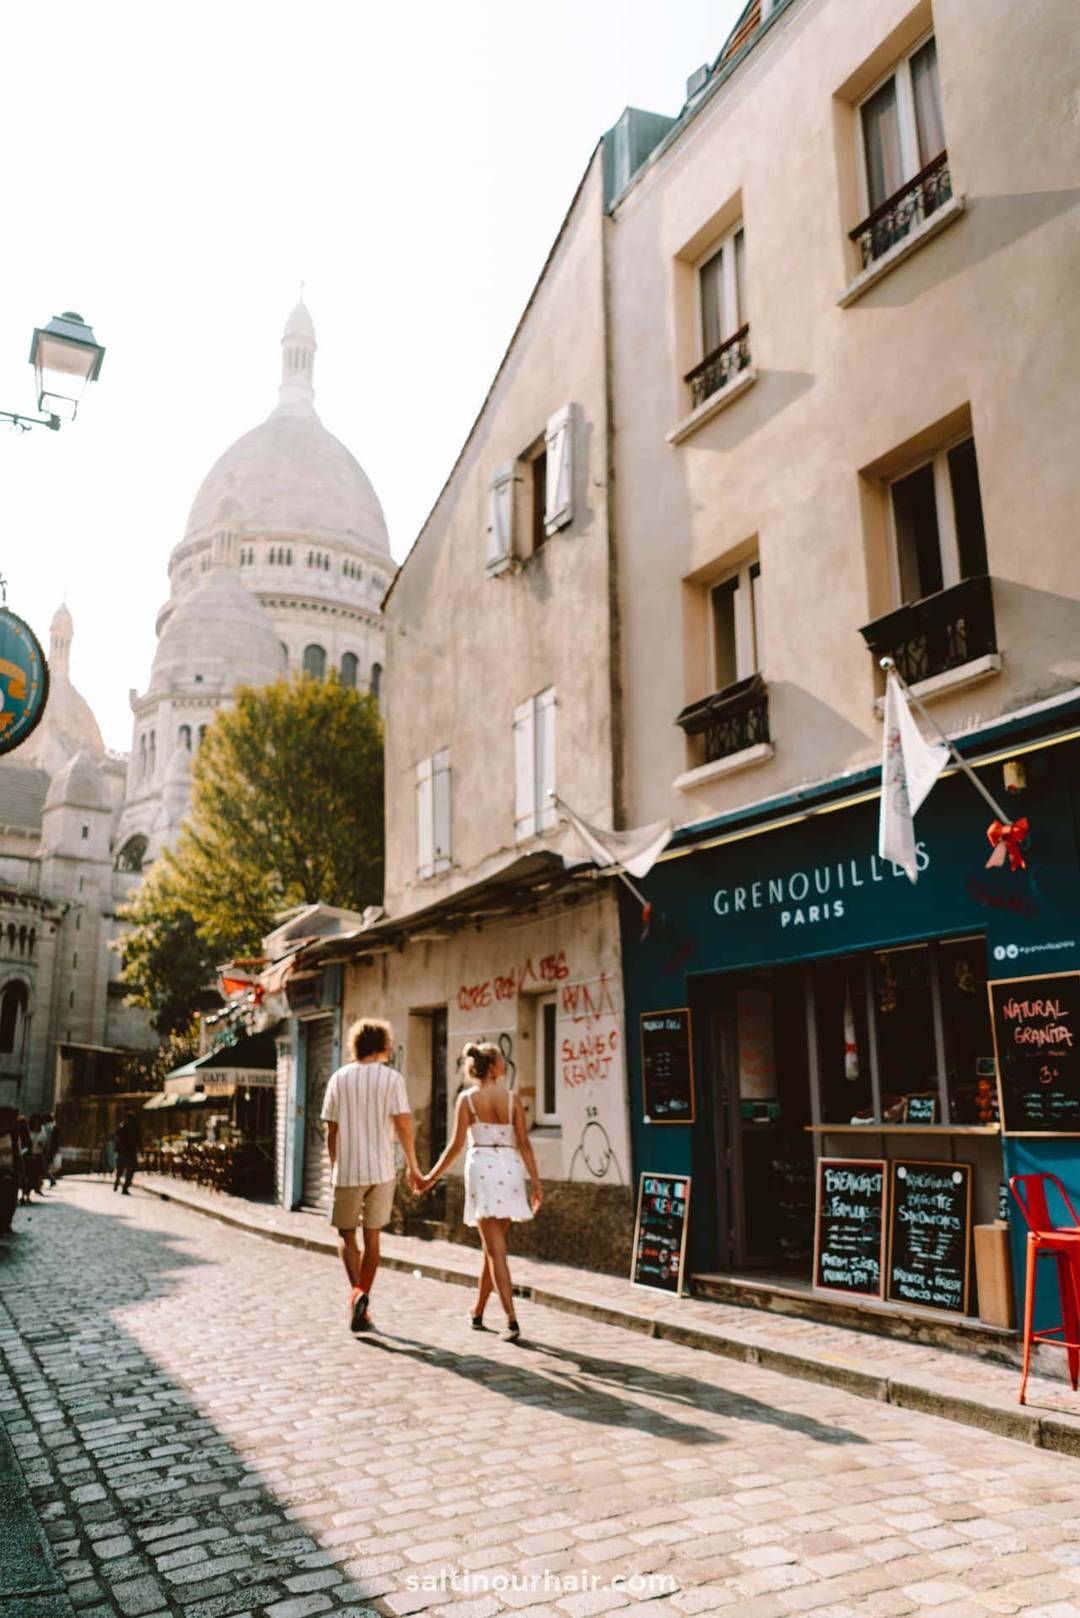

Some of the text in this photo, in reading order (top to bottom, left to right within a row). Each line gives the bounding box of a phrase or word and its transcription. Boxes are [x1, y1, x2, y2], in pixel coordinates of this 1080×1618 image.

[781, 900, 845, 928] PARIS
[1002, 997, 1070, 1023] NATURAL
[1014, 1022, 1074, 1048] GRANITA
[824, 1168, 883, 1197] BREAKFAST
